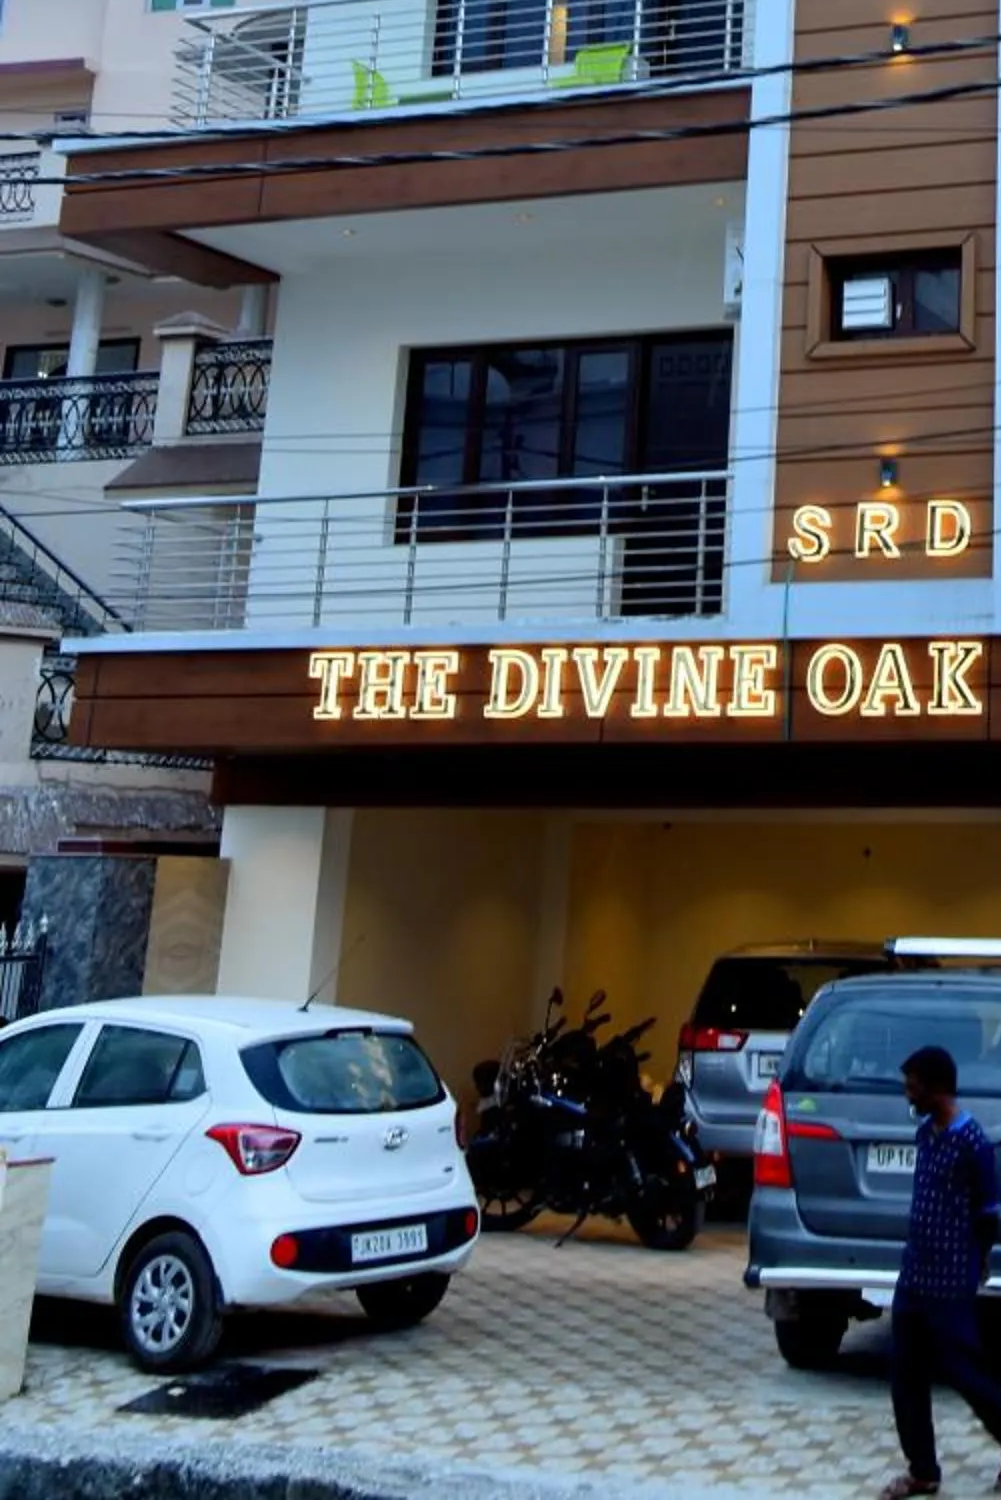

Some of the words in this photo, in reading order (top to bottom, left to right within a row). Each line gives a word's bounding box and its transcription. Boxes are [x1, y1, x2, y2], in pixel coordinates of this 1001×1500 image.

[308, 650, 460, 720] THE
[483, 645, 778, 719] DIVINE
[806, 641, 984, 717] OAK
